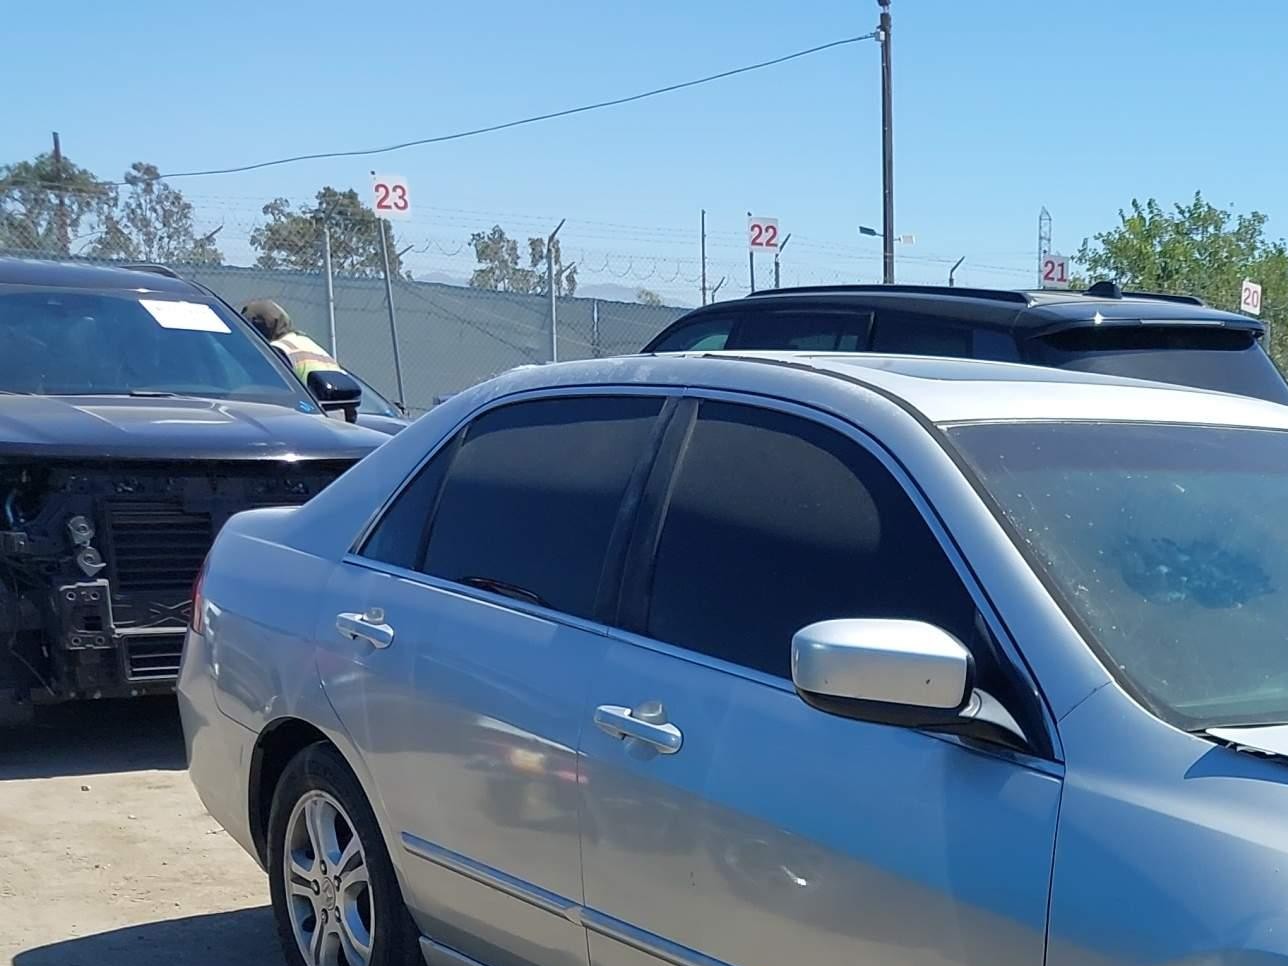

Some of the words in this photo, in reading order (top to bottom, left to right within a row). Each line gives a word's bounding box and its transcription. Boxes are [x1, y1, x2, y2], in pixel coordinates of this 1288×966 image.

[374, 183, 409, 211] 23
[750, 223, 779, 247] 22
[1043, 260, 1067, 282] 21
[1243, 287, 1259, 308] 20
